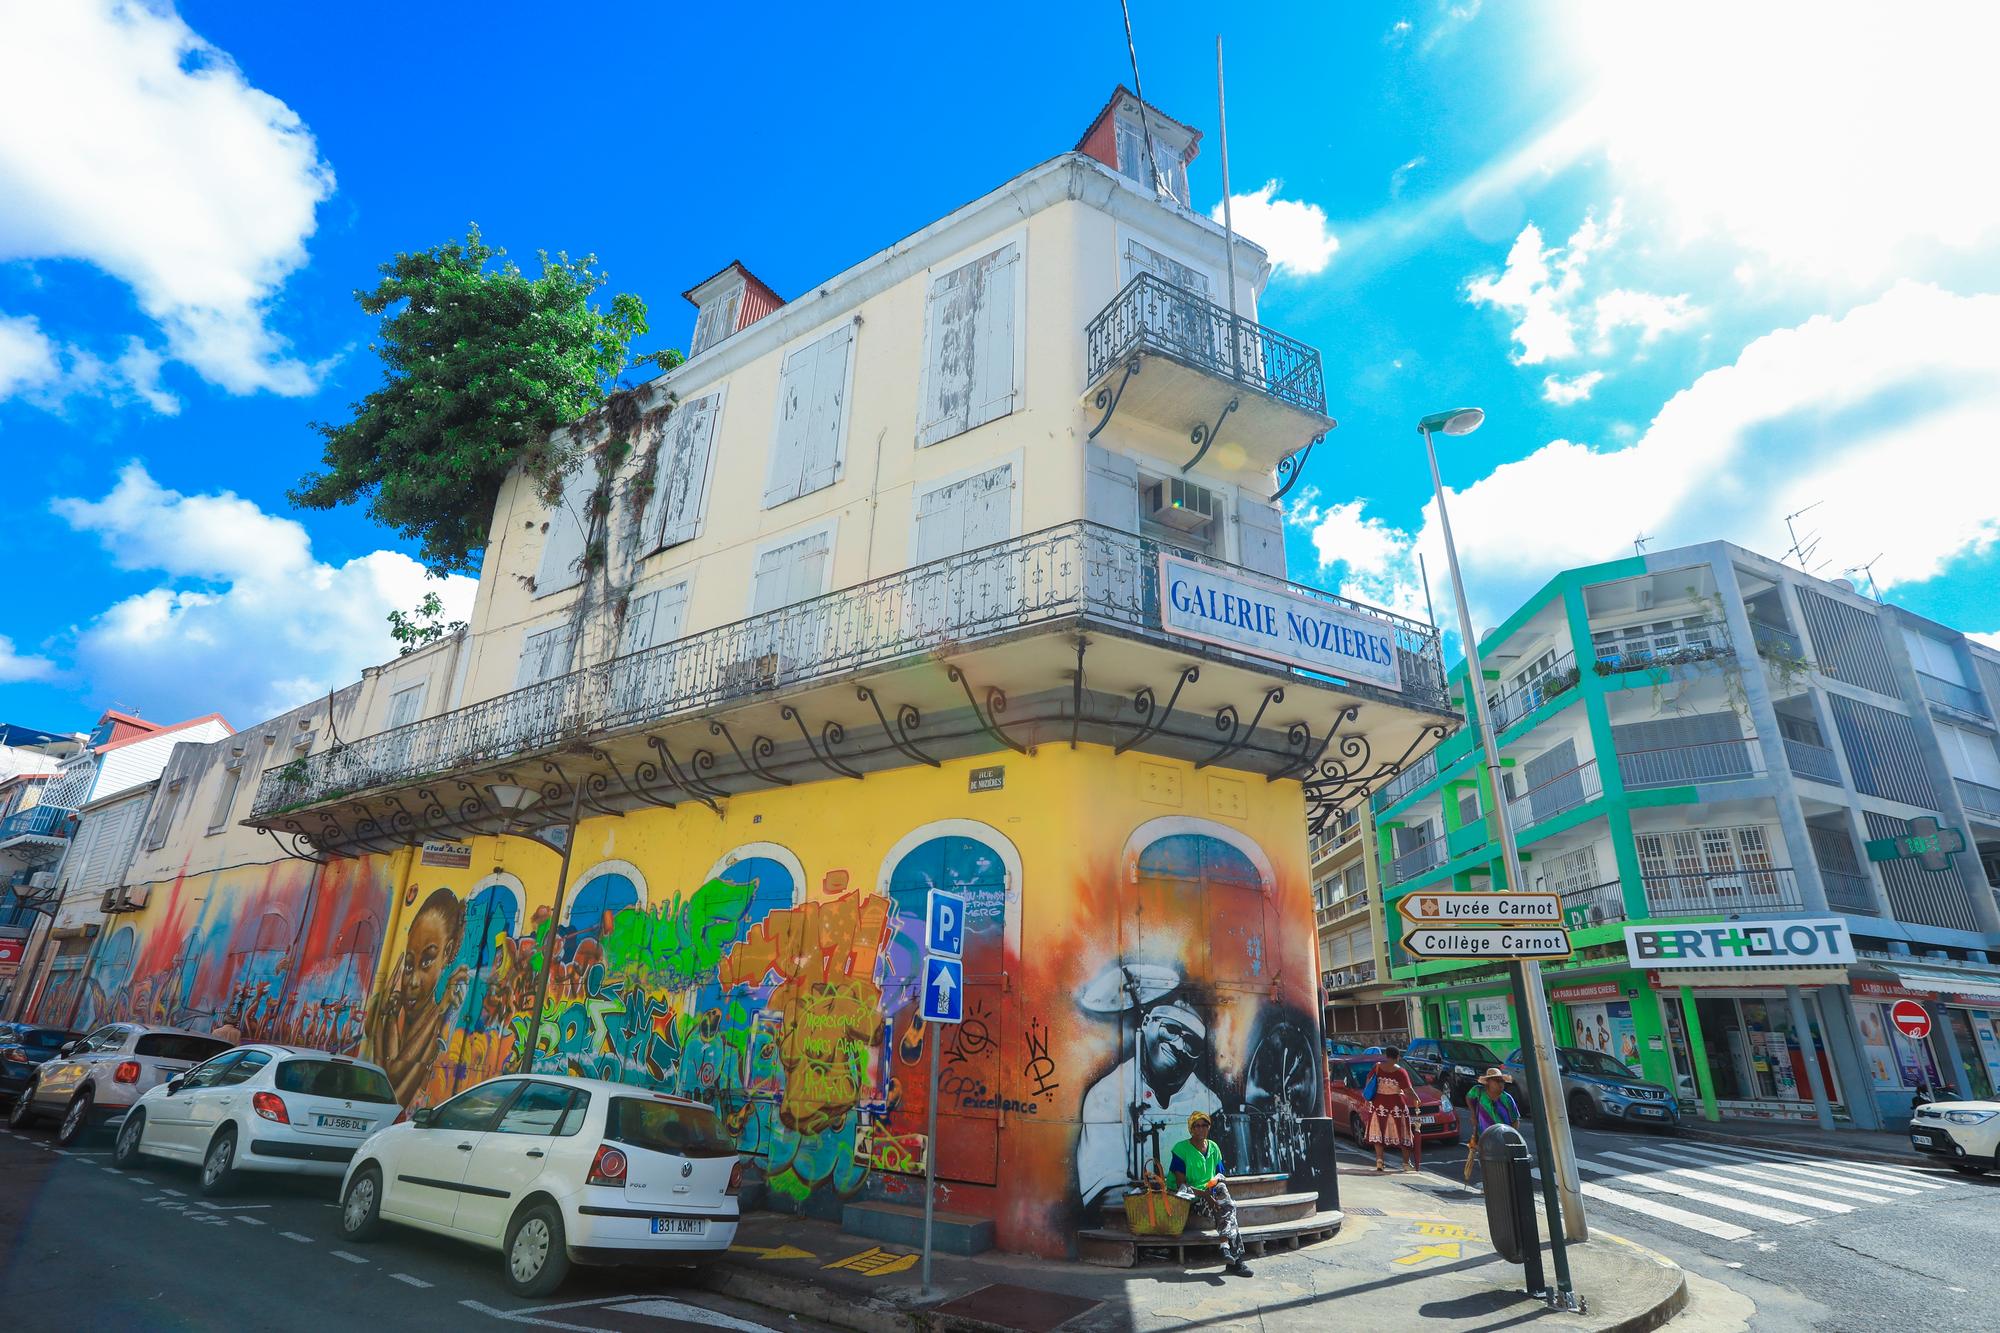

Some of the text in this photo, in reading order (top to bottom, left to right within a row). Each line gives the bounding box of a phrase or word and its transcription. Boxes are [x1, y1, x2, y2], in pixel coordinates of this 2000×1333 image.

[1171, 580, 1392, 666] GALERIE NOZIERES
[979, 771, 994, 779] RUE
[1445, 900, 1553, 917] Lycée Carnot
[939, 904, 955, 942] P
[1425, 935, 1561, 953] Collège Carnot
[658, 1219, 675, 1232] 831
